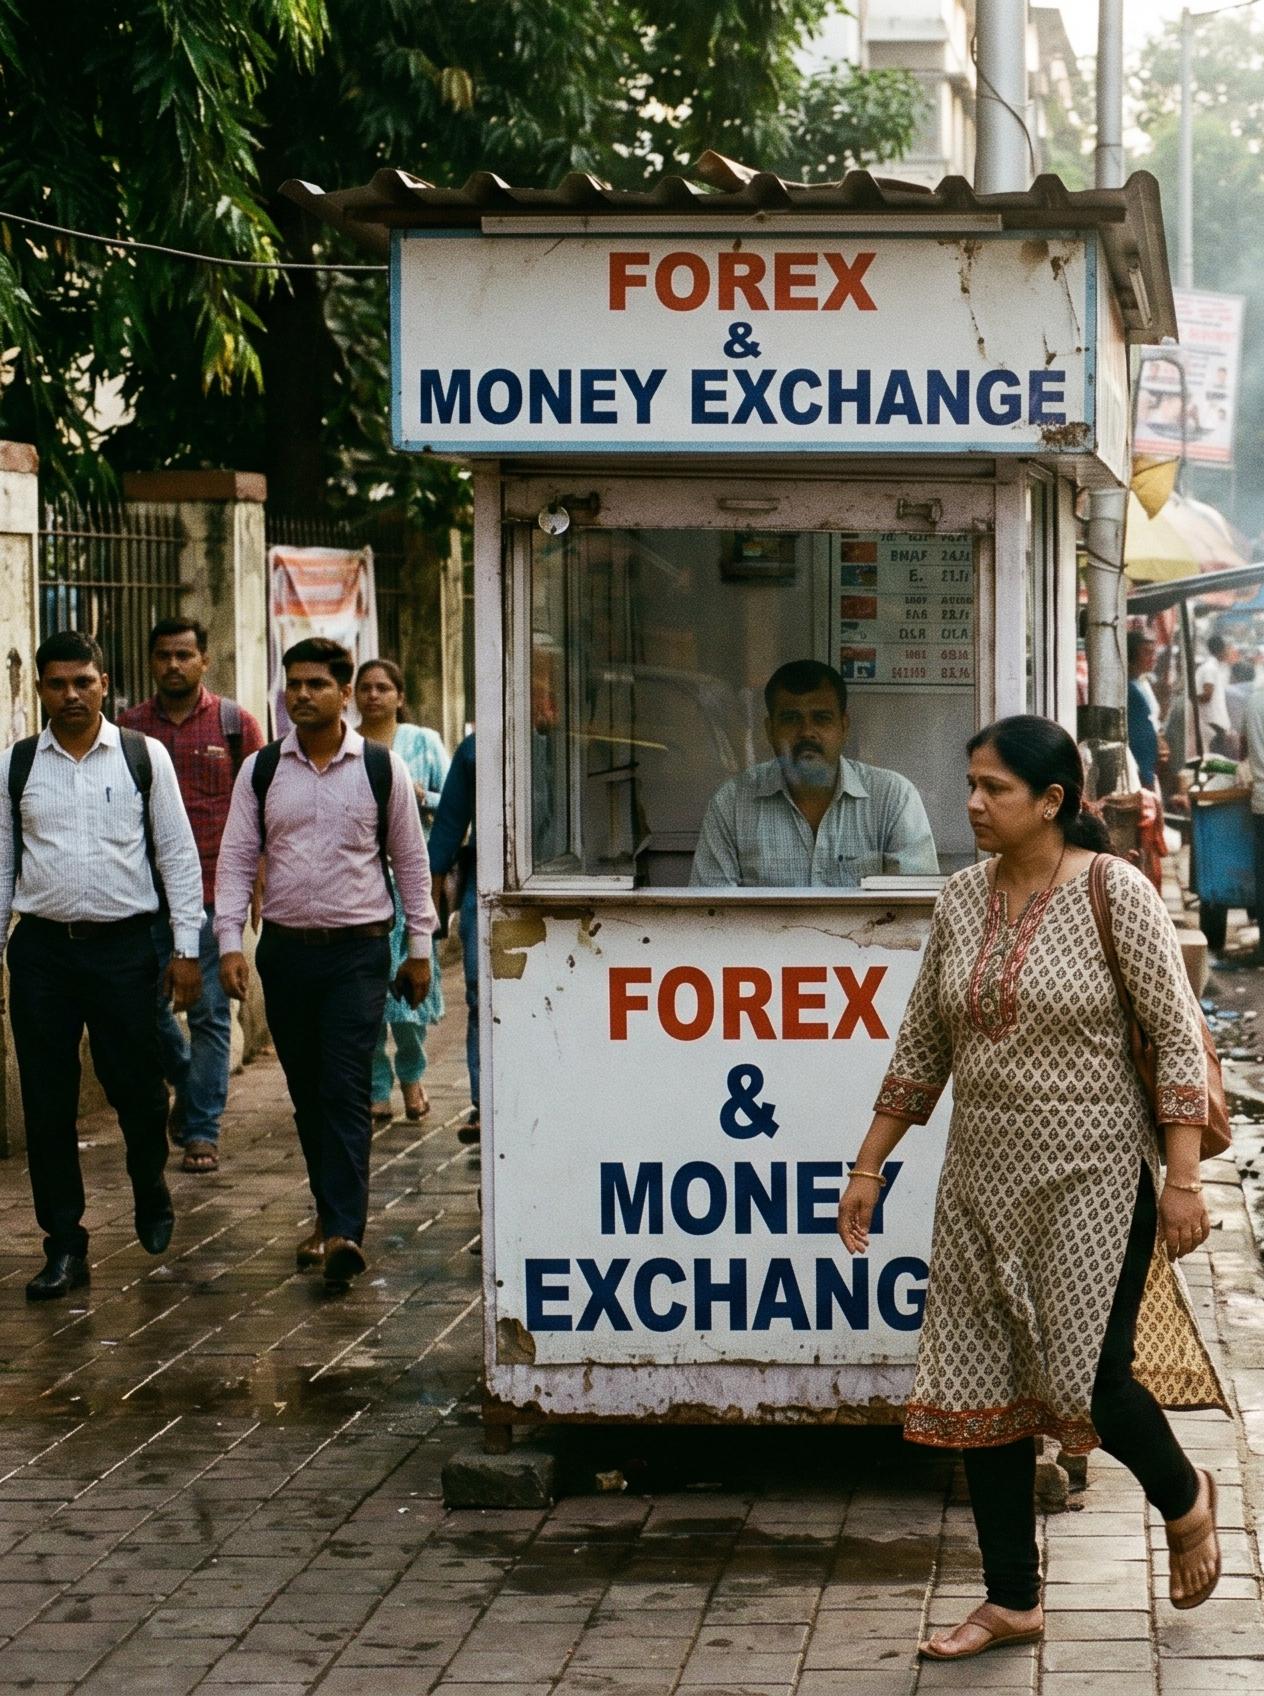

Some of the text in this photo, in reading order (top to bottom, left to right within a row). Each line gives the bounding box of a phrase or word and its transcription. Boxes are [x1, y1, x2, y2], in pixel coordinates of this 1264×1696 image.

[607, 251, 878, 312] FOREX
[723, 321, 762, 359] &
[419, 368, 1067, 426] MONEY EXCHANGE
[608, 965, 890, 1042] FOREX
[719, 1063, 780, 1140] &
[600, 1160, 904, 1236] MONEY
[524, 1256, 930, 1333] EXCHANG
